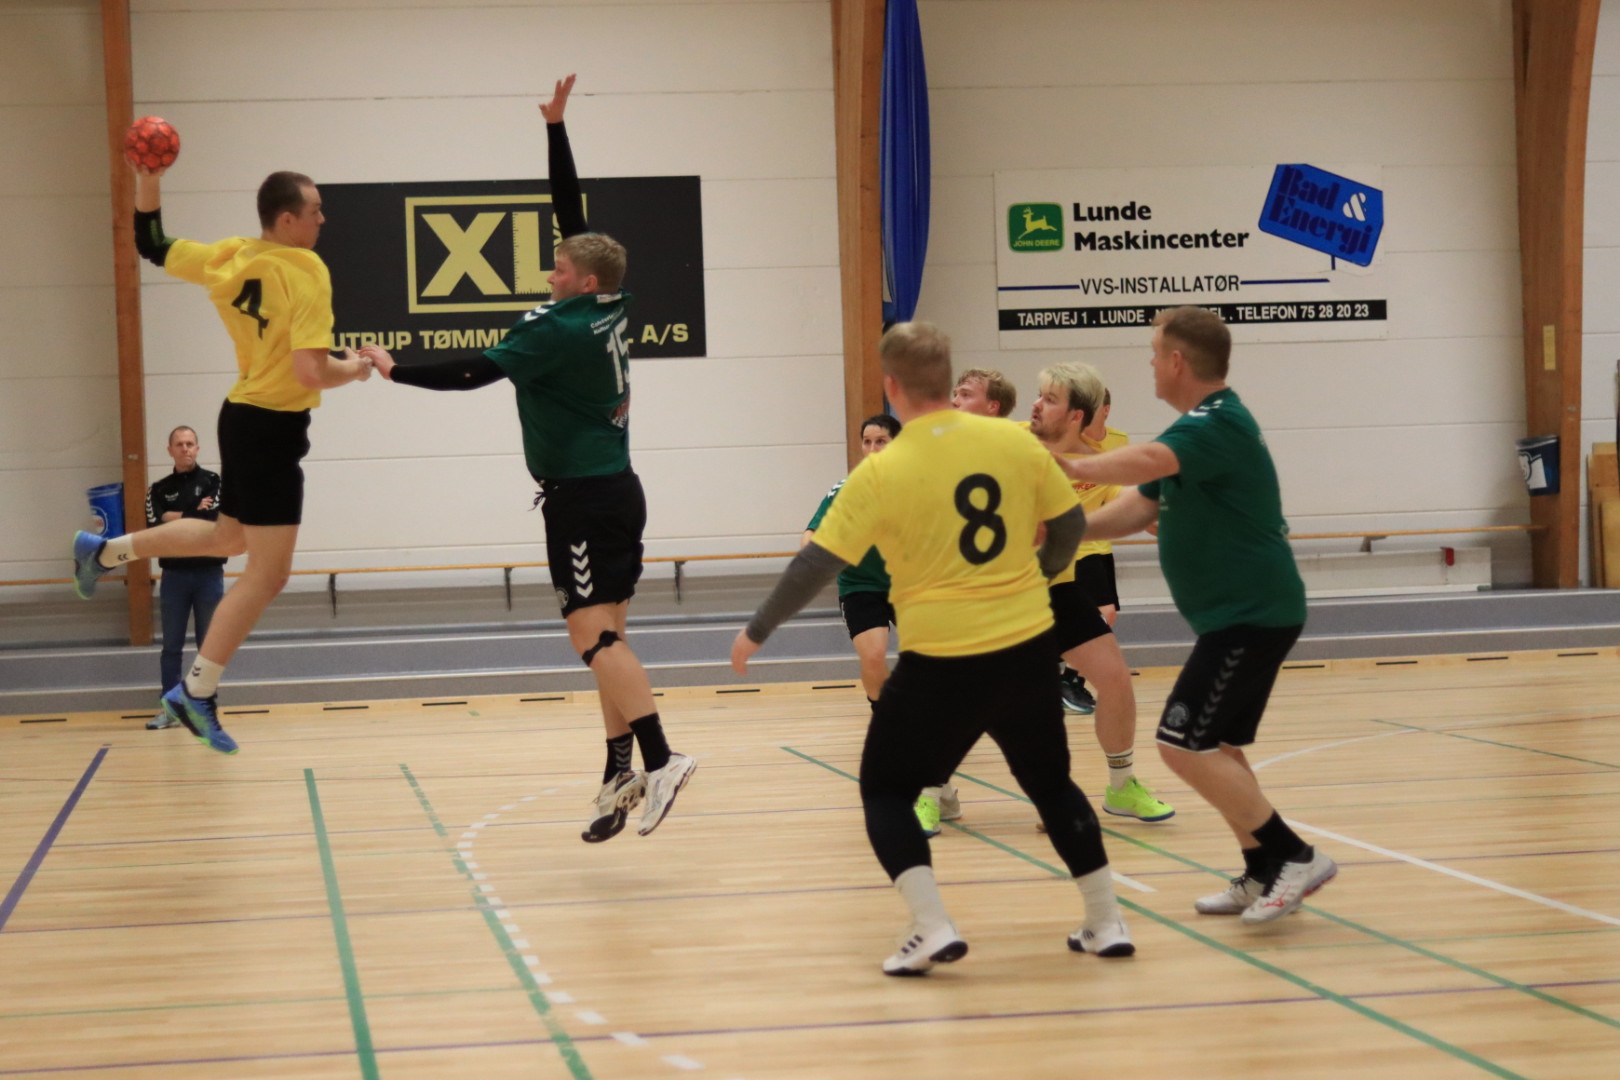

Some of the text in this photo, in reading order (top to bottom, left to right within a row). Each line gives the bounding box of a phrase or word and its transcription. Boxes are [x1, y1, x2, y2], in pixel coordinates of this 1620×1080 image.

[1278, 166, 1340, 211] Bad
[1073, 201, 1152, 221] Lunde
[1269, 193, 1372, 254] Energi
[420, 210, 554, 298] XL
[1013, 239, 1060, 248] JOHN DEERE
[1074, 229, 1249, 251] Maskincenter
[1080, 275, 1240, 295] VVS-INSTALLATØR
[231, 278, 269, 340] 4
[1017, 311, 1078, 326] TARPVEJ
[1100, 309, 1145, 324] LUNDE
[1236, 305, 1297, 320] TELEFON
[1300, 304, 1315, 319] 75
[1318, 304, 1333, 318] 28
[1337, 304, 1350, 318] 20
[1354, 303, 1369, 317] 23
[331, 331, 411, 351] UTRUP
[641, 323, 689, 346] A/S
[954, 472, 1007, 565] 8
